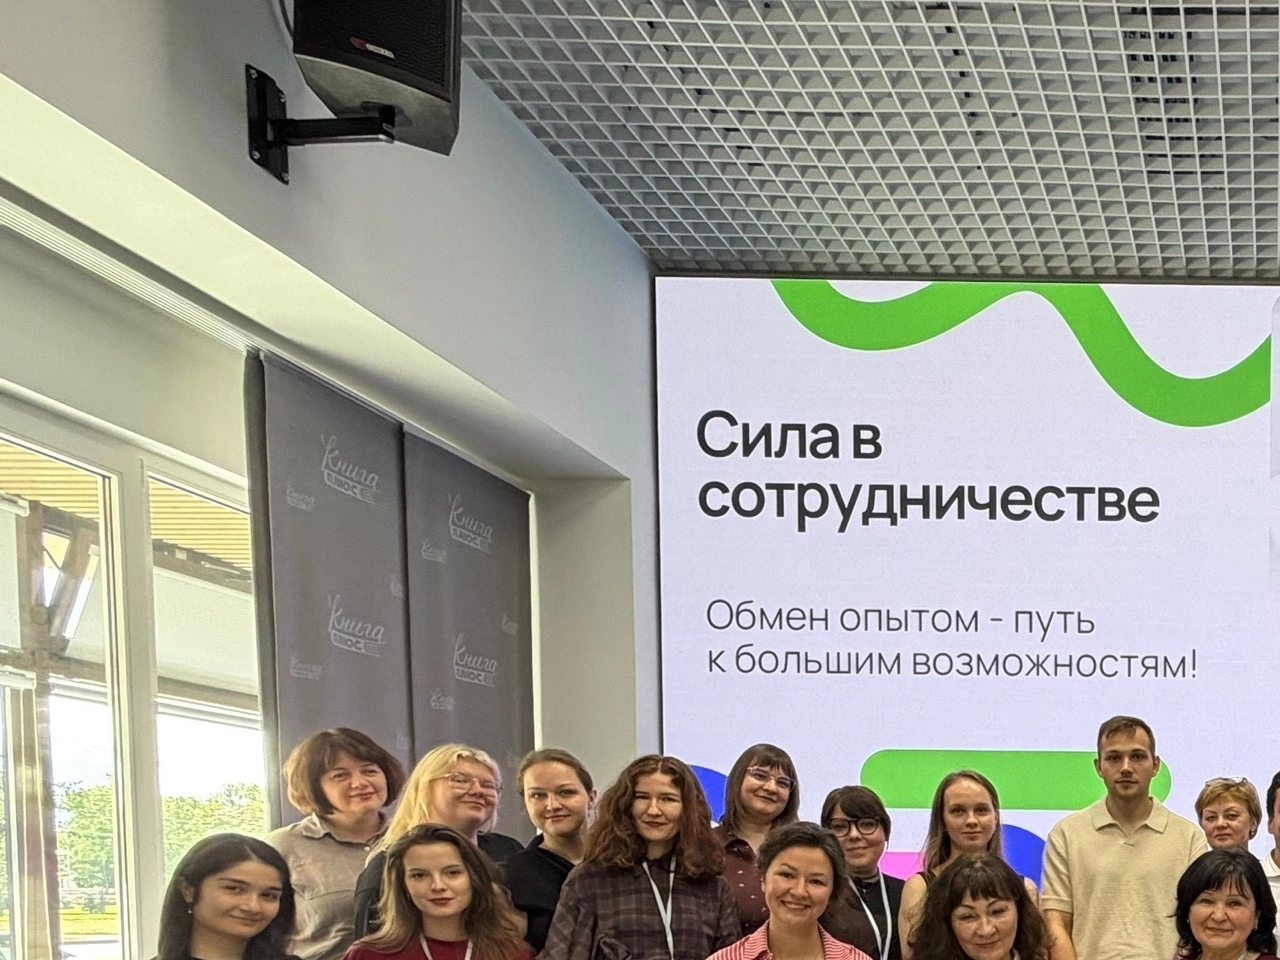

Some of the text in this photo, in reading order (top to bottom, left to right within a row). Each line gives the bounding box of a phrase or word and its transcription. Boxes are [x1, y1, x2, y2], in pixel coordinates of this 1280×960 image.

[697, 410, 882, 459] Сила в
[699, 481, 1160, 533] сотрудничестве
[706, 599, 829, 631] Обмен
[840, 608, 978, 632] опытом
[1015, 610, 1095, 642] путь
[708, 643, 1196, 678] к большим возможностям!
